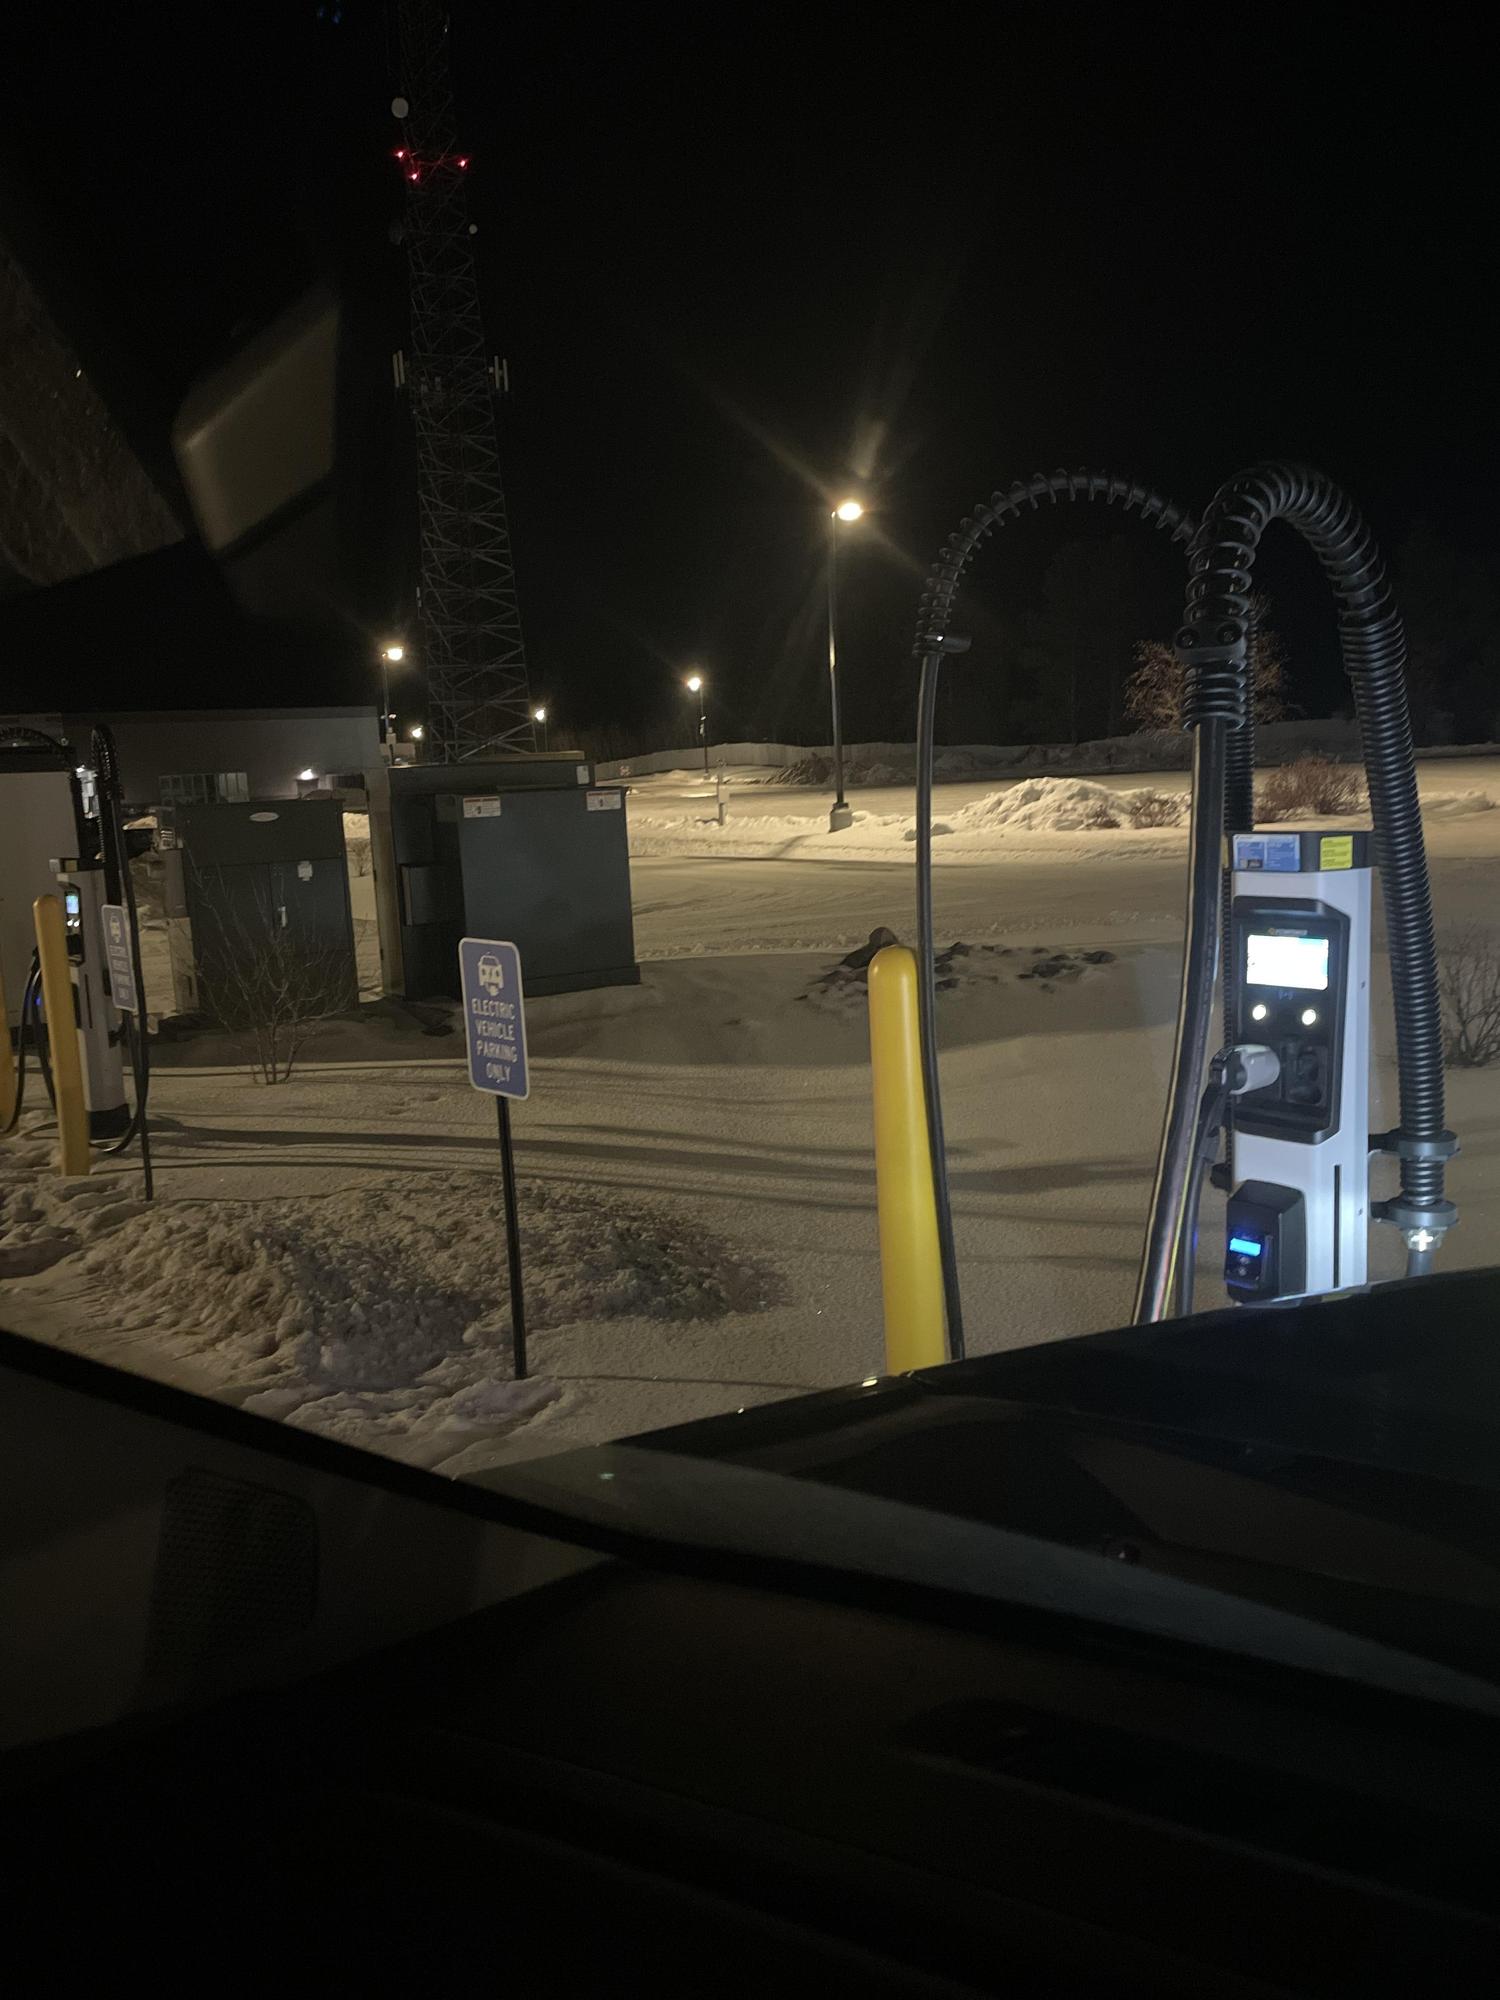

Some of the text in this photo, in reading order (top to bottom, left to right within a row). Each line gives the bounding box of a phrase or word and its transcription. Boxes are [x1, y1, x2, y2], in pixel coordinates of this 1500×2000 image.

[472, 998, 515, 1020] ELECTRIC
[475, 1019, 515, 1040] VEHICLE
[477, 1040, 517, 1063] PARKING
[486, 1062, 511, 1083] ONLY
